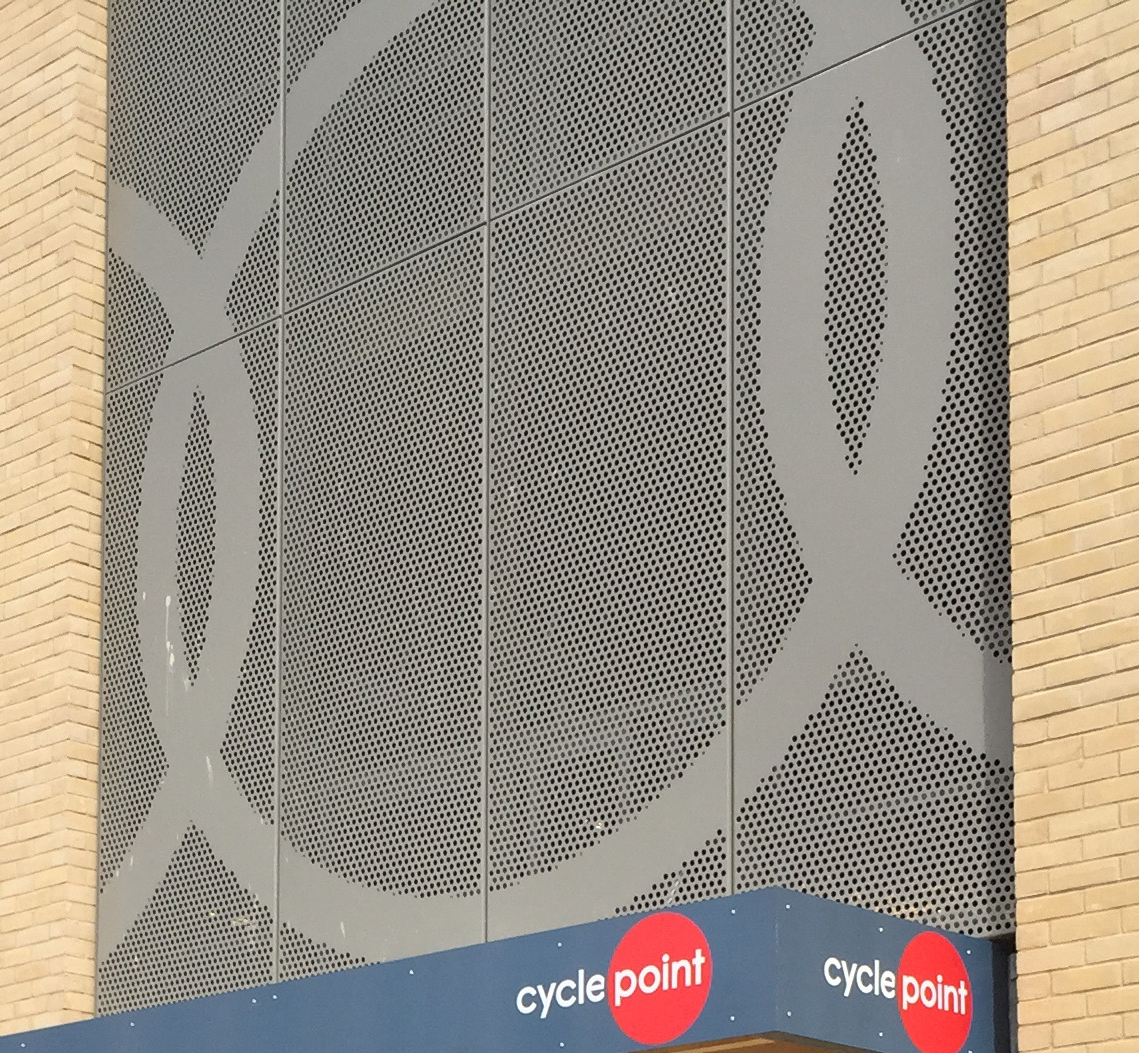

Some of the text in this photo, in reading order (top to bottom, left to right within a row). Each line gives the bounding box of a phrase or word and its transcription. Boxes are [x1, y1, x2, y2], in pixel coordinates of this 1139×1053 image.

[516, 948, 706, 1019] cycle point
[823, 956, 968, 1016] cycle point
